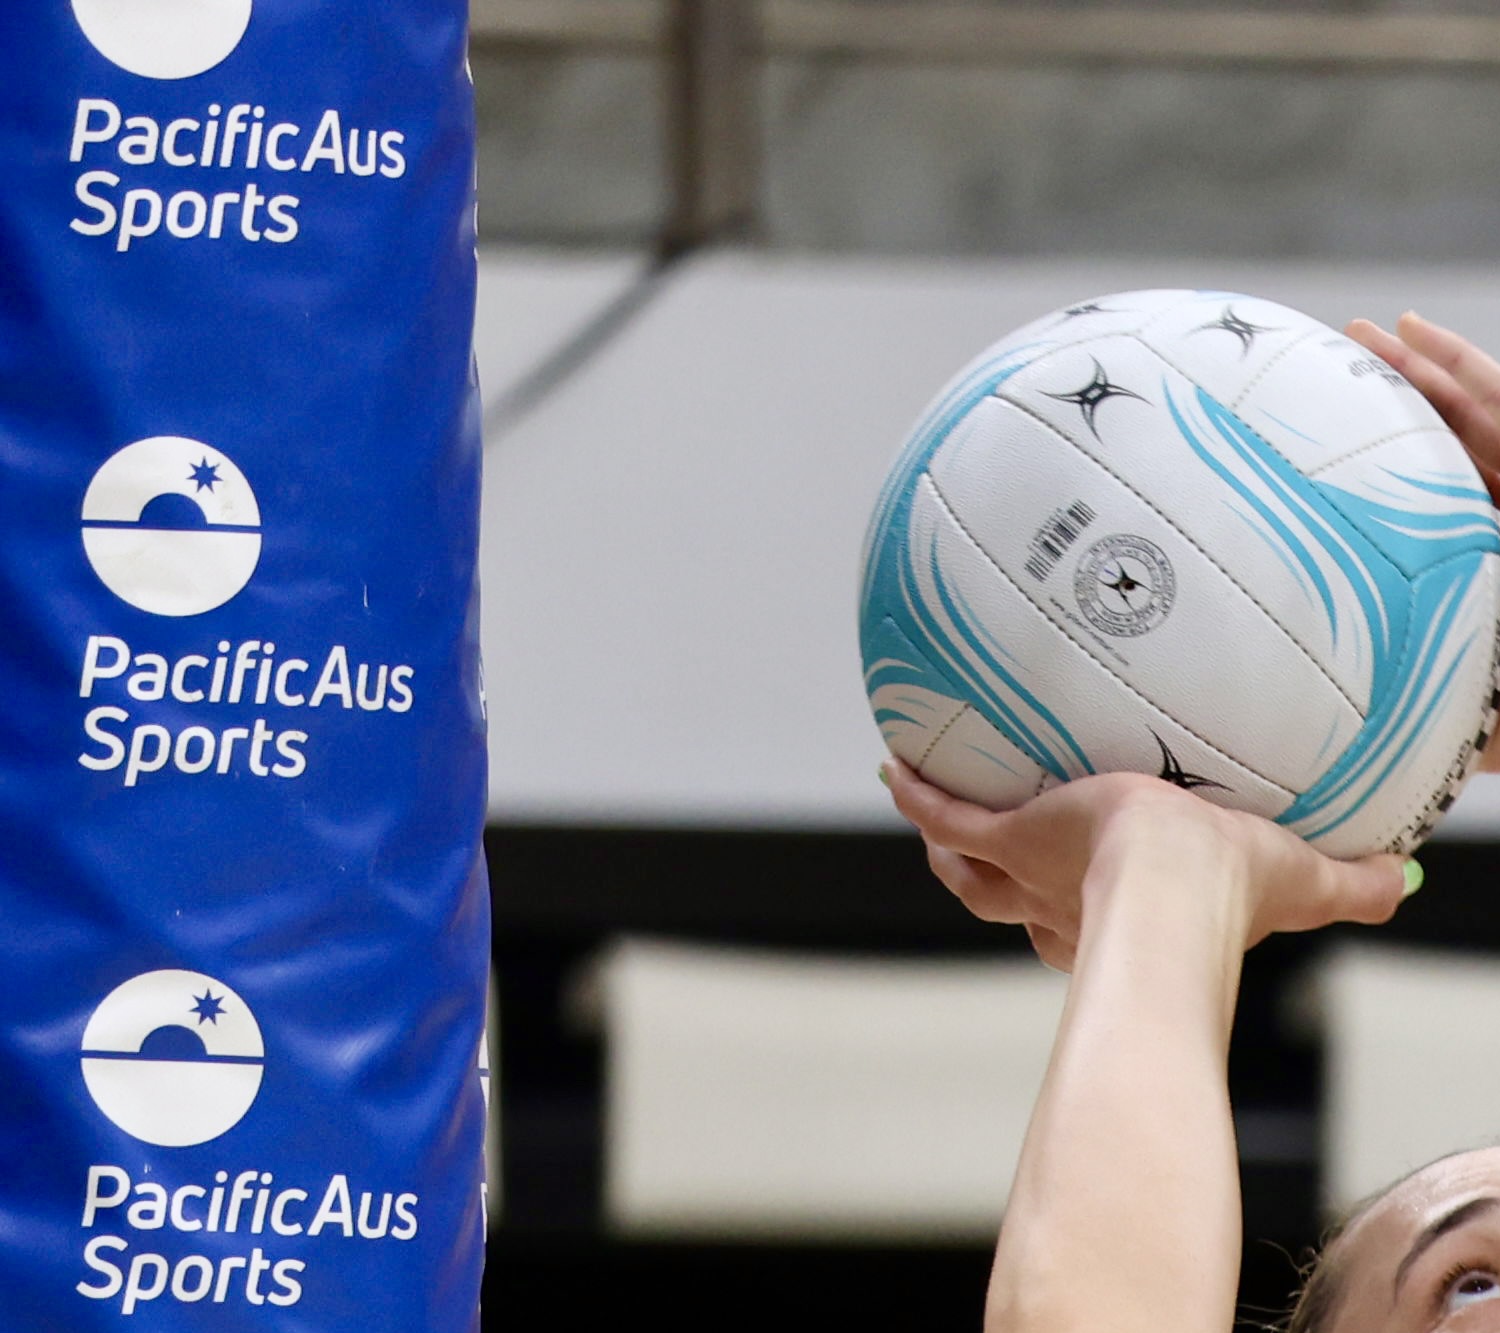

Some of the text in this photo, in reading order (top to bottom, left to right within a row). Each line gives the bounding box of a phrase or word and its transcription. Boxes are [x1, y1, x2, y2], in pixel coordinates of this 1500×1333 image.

[70, 98, 405, 178] PacificAus
[70, 170, 299, 252] Sports
[80, 636, 414, 712] PacificAus
[79, 706, 308, 786] Sports
[82, 1165, 418, 1240] PacificAus
[76, 1235, 305, 1315] Sports
